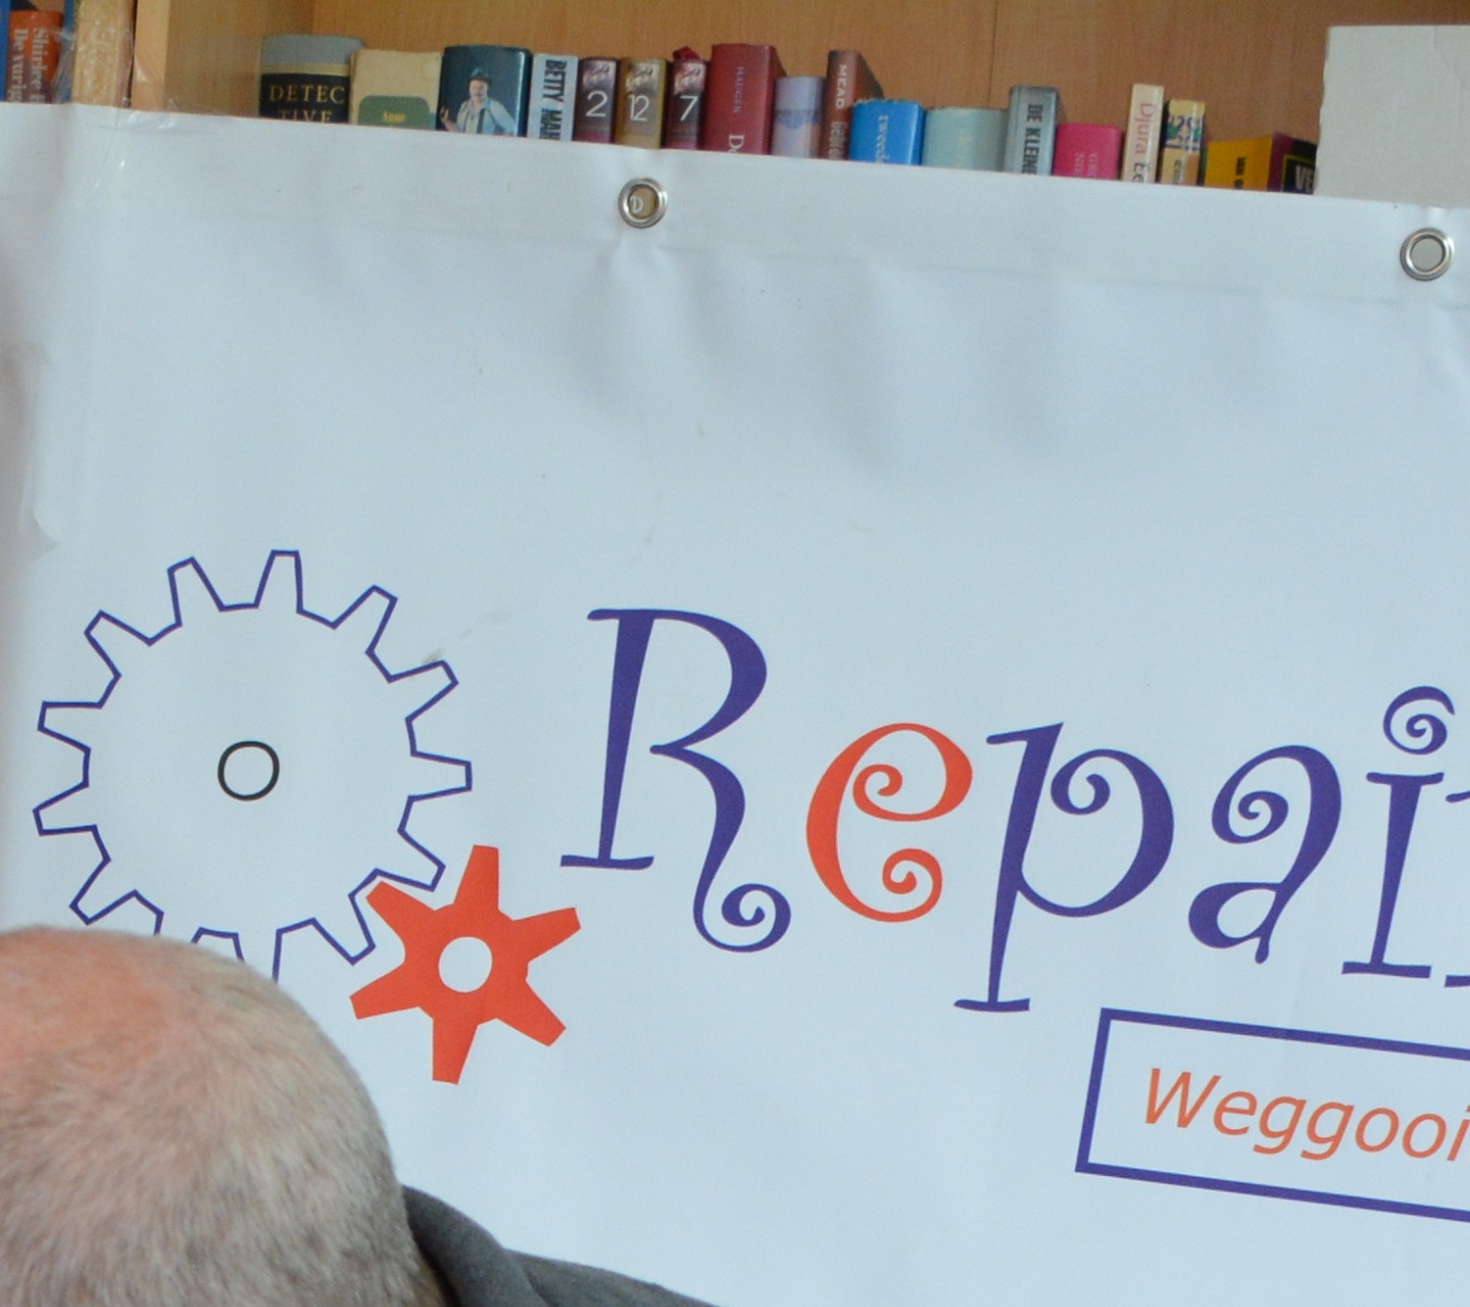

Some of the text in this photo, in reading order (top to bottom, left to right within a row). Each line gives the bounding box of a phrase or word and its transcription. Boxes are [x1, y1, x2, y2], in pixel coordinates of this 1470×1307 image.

[269, 84, 346, 104] DETEC
[543, 60, 567, 103] BETTY
[835, 64, 849, 109] MEAD
[586, 91, 608, 118] 2
[628, 95, 650, 121] 12
[679, 95, 699, 121] 7
[1027, 104, 1044, 122] DE
[1135, 102, 1158, 154] Djura
